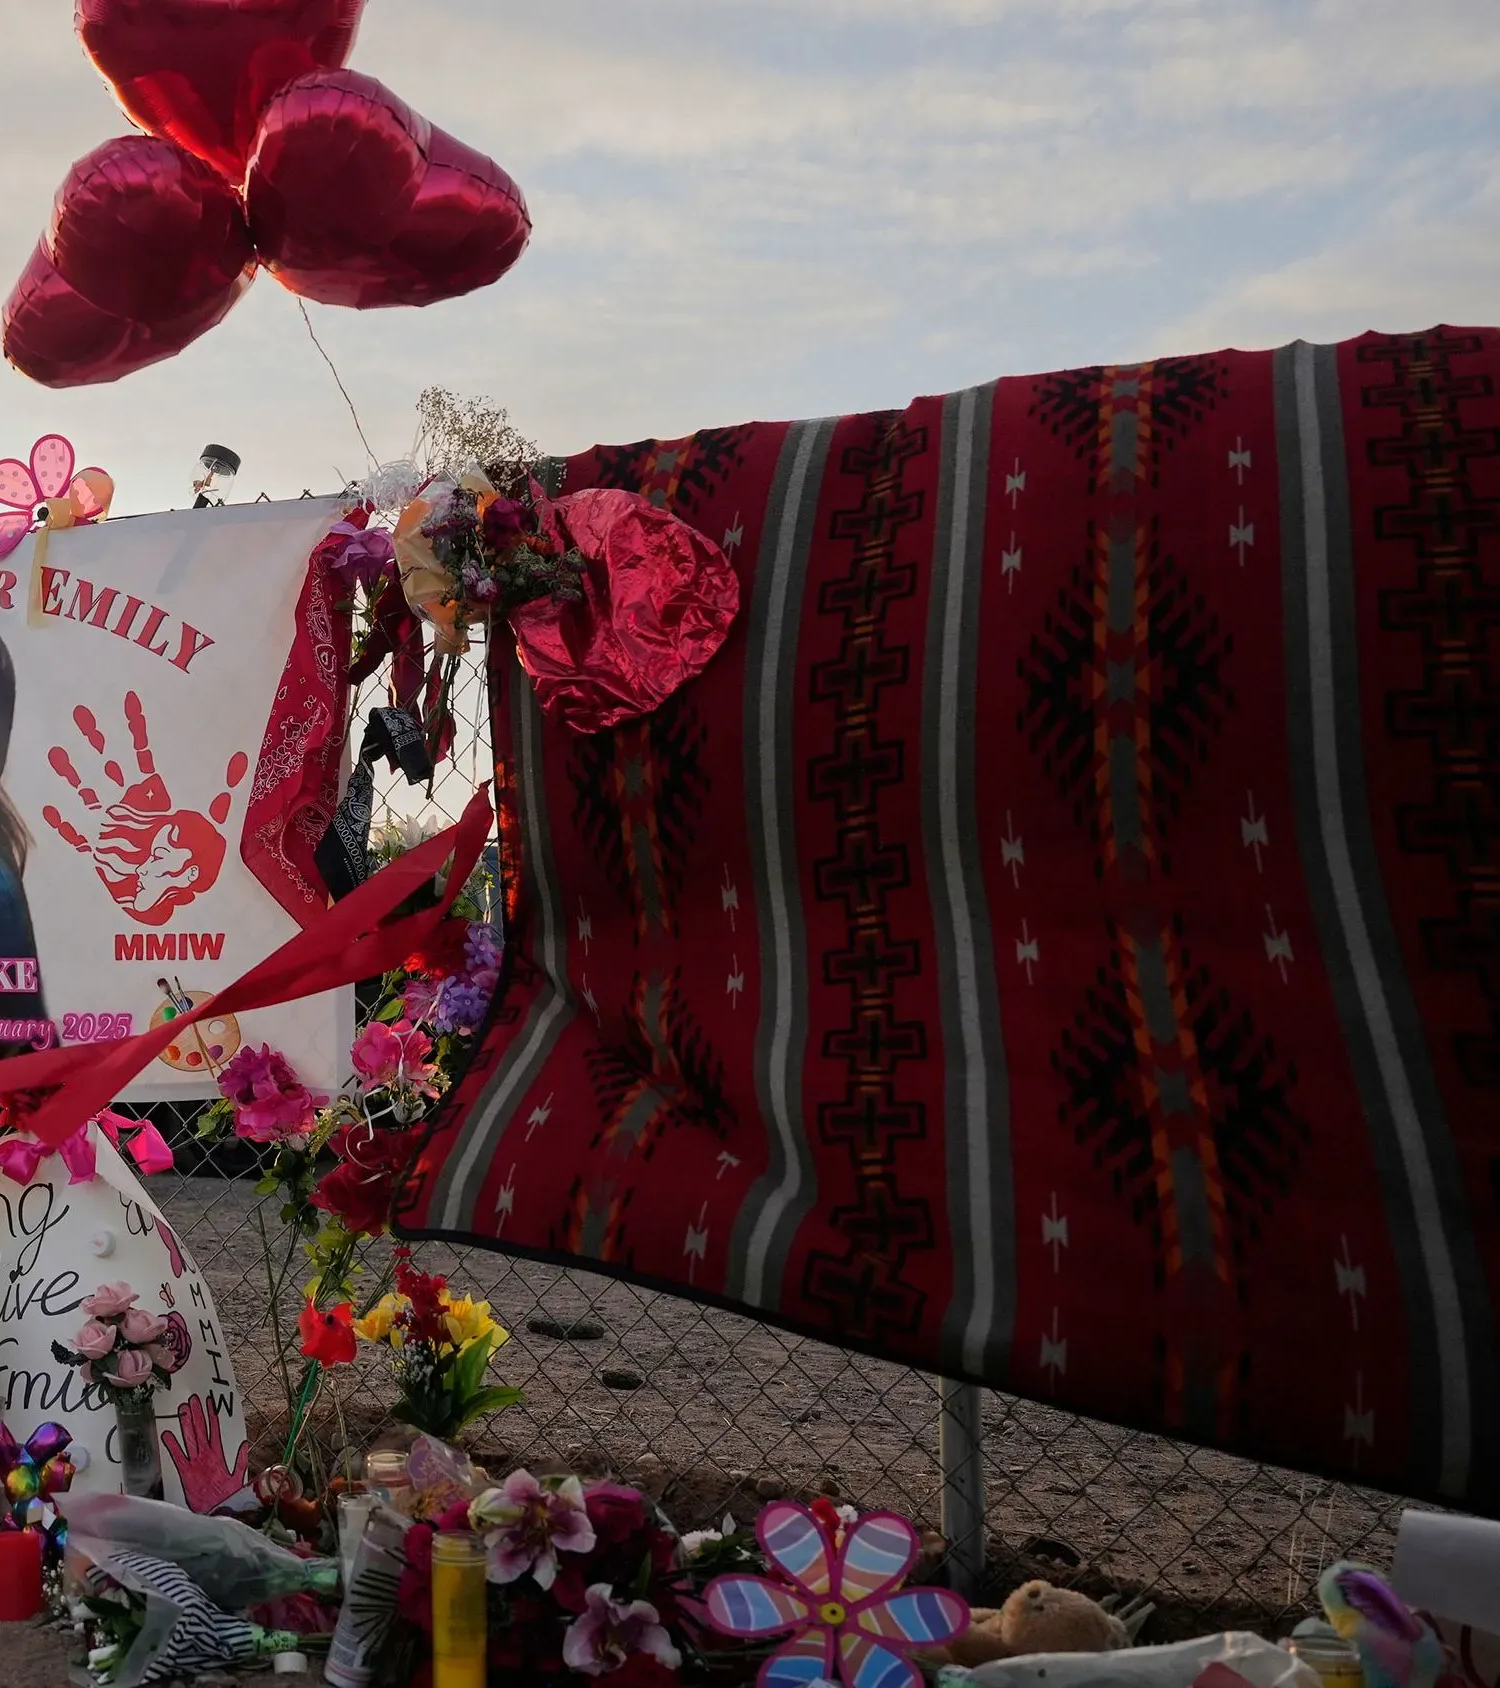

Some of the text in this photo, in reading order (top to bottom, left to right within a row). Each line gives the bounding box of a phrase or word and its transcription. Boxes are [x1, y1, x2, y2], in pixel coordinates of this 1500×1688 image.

[41, 566, 215, 674] EMILY
[115, 933, 225, 960] MMIW
[63, 1014, 132, 1041] 2025
